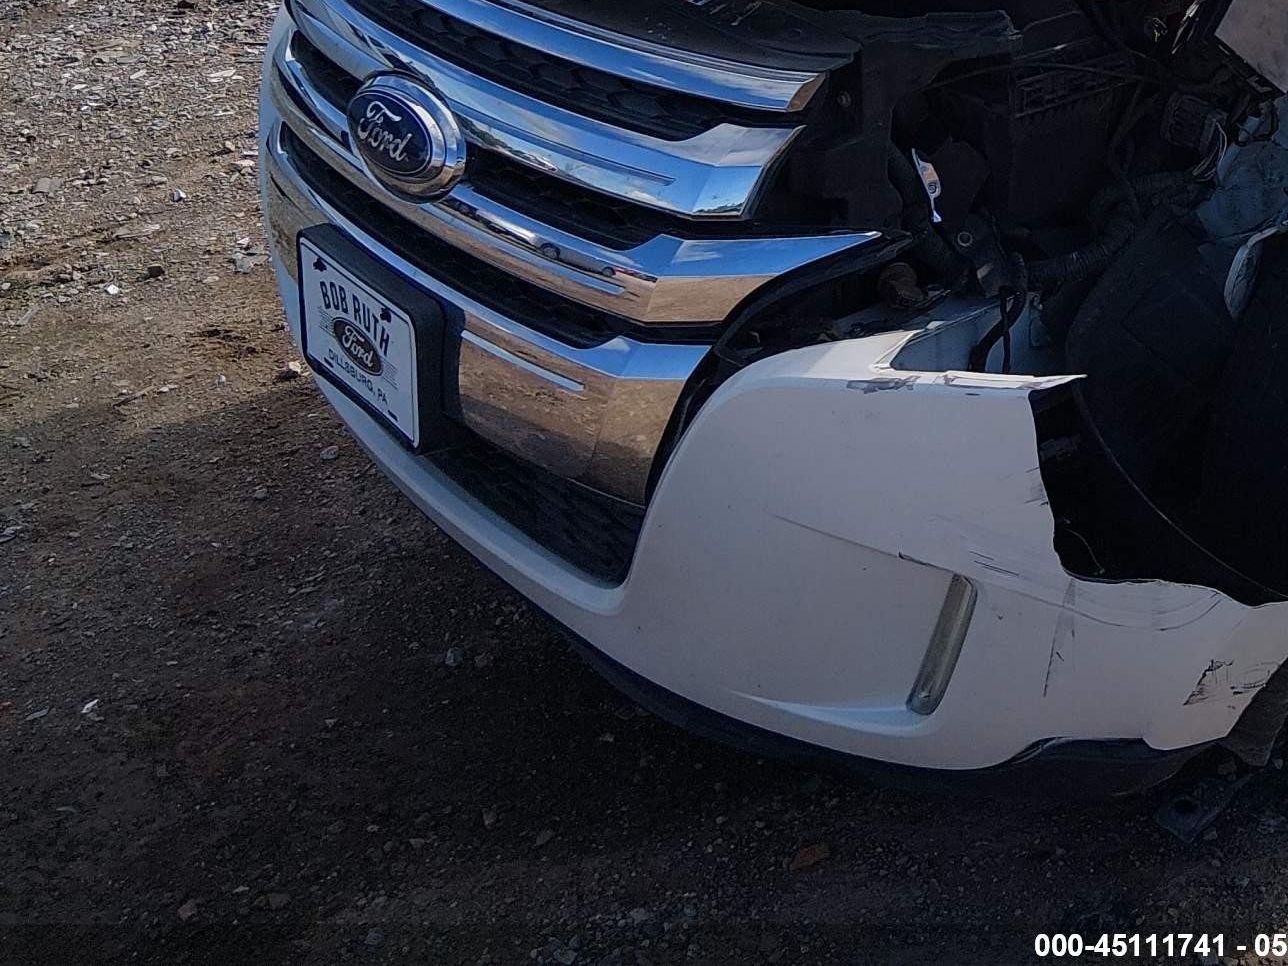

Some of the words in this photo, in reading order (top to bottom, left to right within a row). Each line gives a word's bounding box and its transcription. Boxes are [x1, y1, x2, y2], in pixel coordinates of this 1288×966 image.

[356, 99, 411, 163] Ford
[319, 280, 349, 315] BOB
[352, 293, 390, 357] RUTH
[342, 325, 375, 368] Ford
[376, 387, 389, 406] PA
